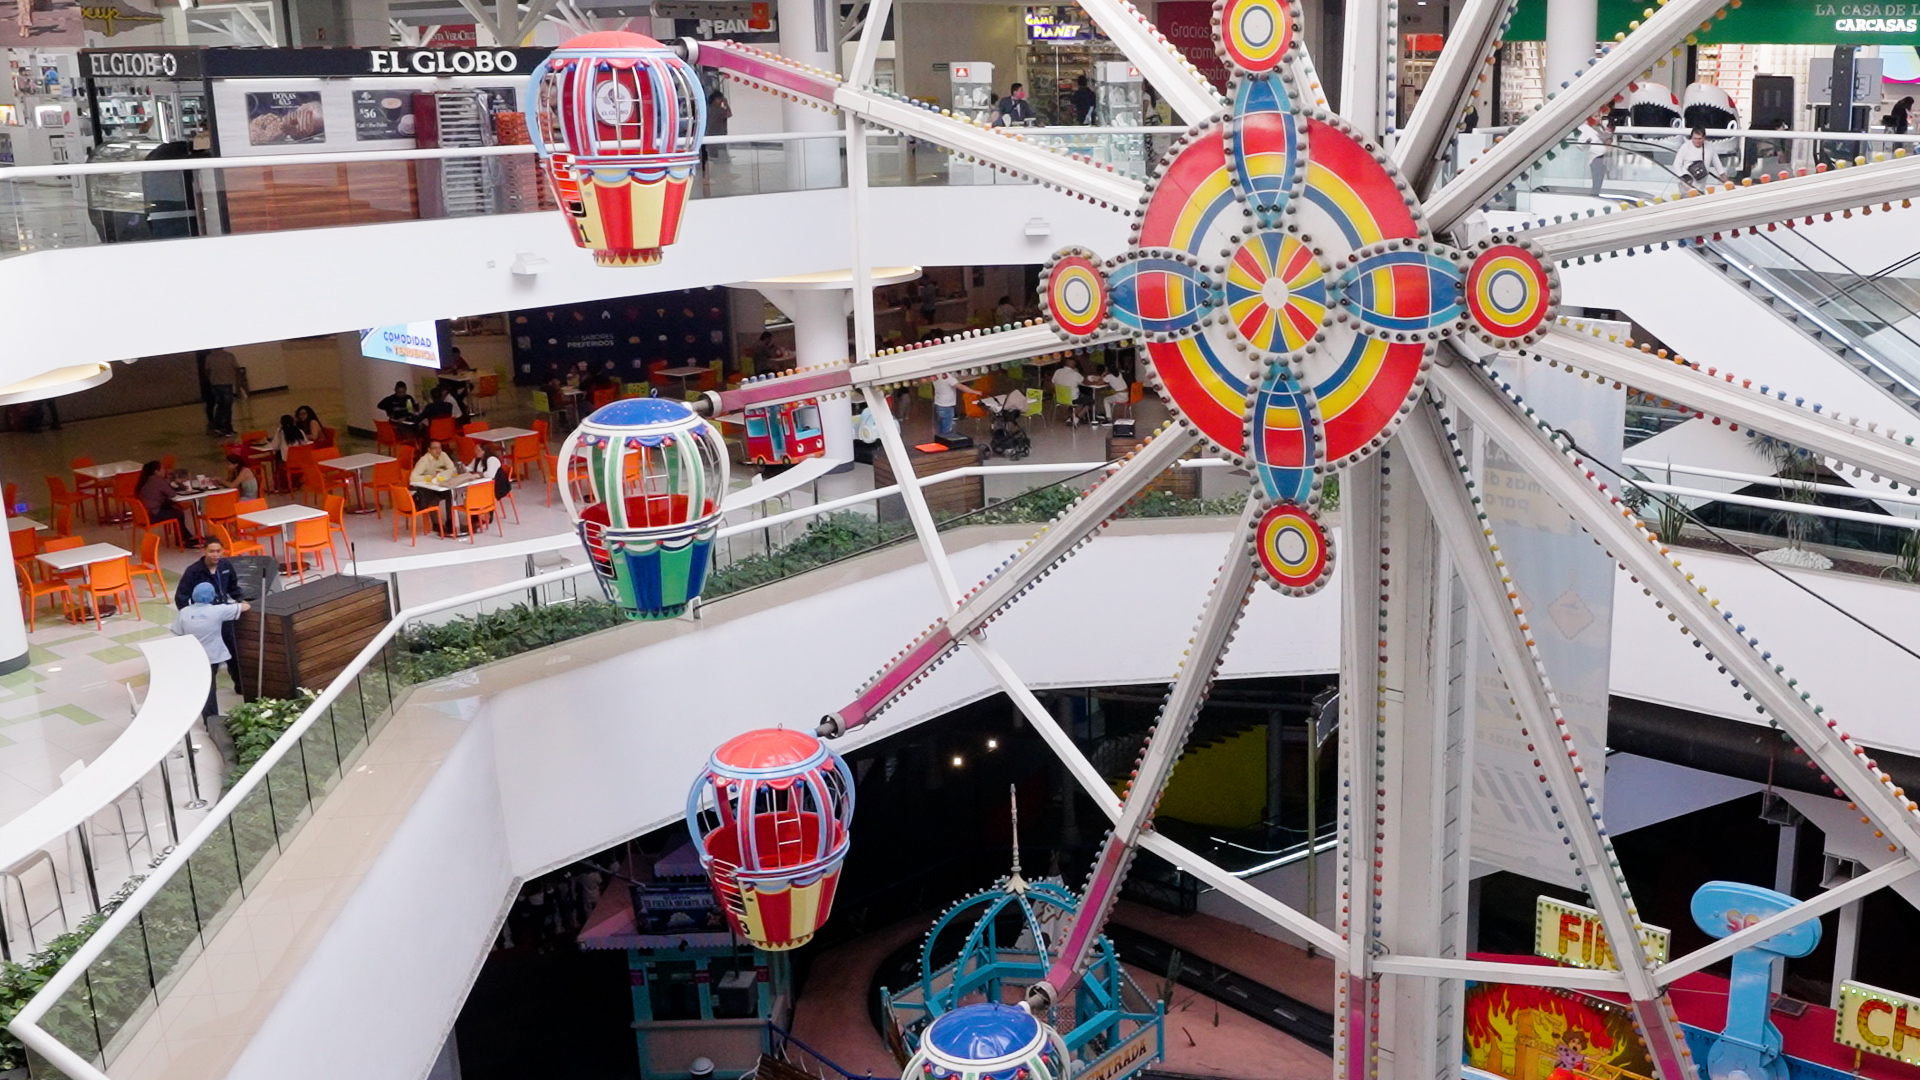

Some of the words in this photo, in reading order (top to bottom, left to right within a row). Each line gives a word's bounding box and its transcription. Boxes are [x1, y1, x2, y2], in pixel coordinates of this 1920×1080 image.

[1815, 4, 1836, 16] LA
[1841, 4, 1881, 16] CASA
[1885, 4, 1906, 16] DE
[1911, 4, 1920, 16] L
[1025, 14, 1055, 26] GAME
[1835, 18, 1918, 32] CARCASAS
[1033, 25, 1081, 38] PLANET
[1171, 22, 1210, 39] Gracias
[90, 53, 111, 76] EL
[110, 52, 177, 76] GLOBO
[370, 50, 409, 73] EL
[412, 50, 518, 74] GLOBO
[383, 331, 432, 348] COMODIDAD
[1856, 998, 1920, 1053] CH
